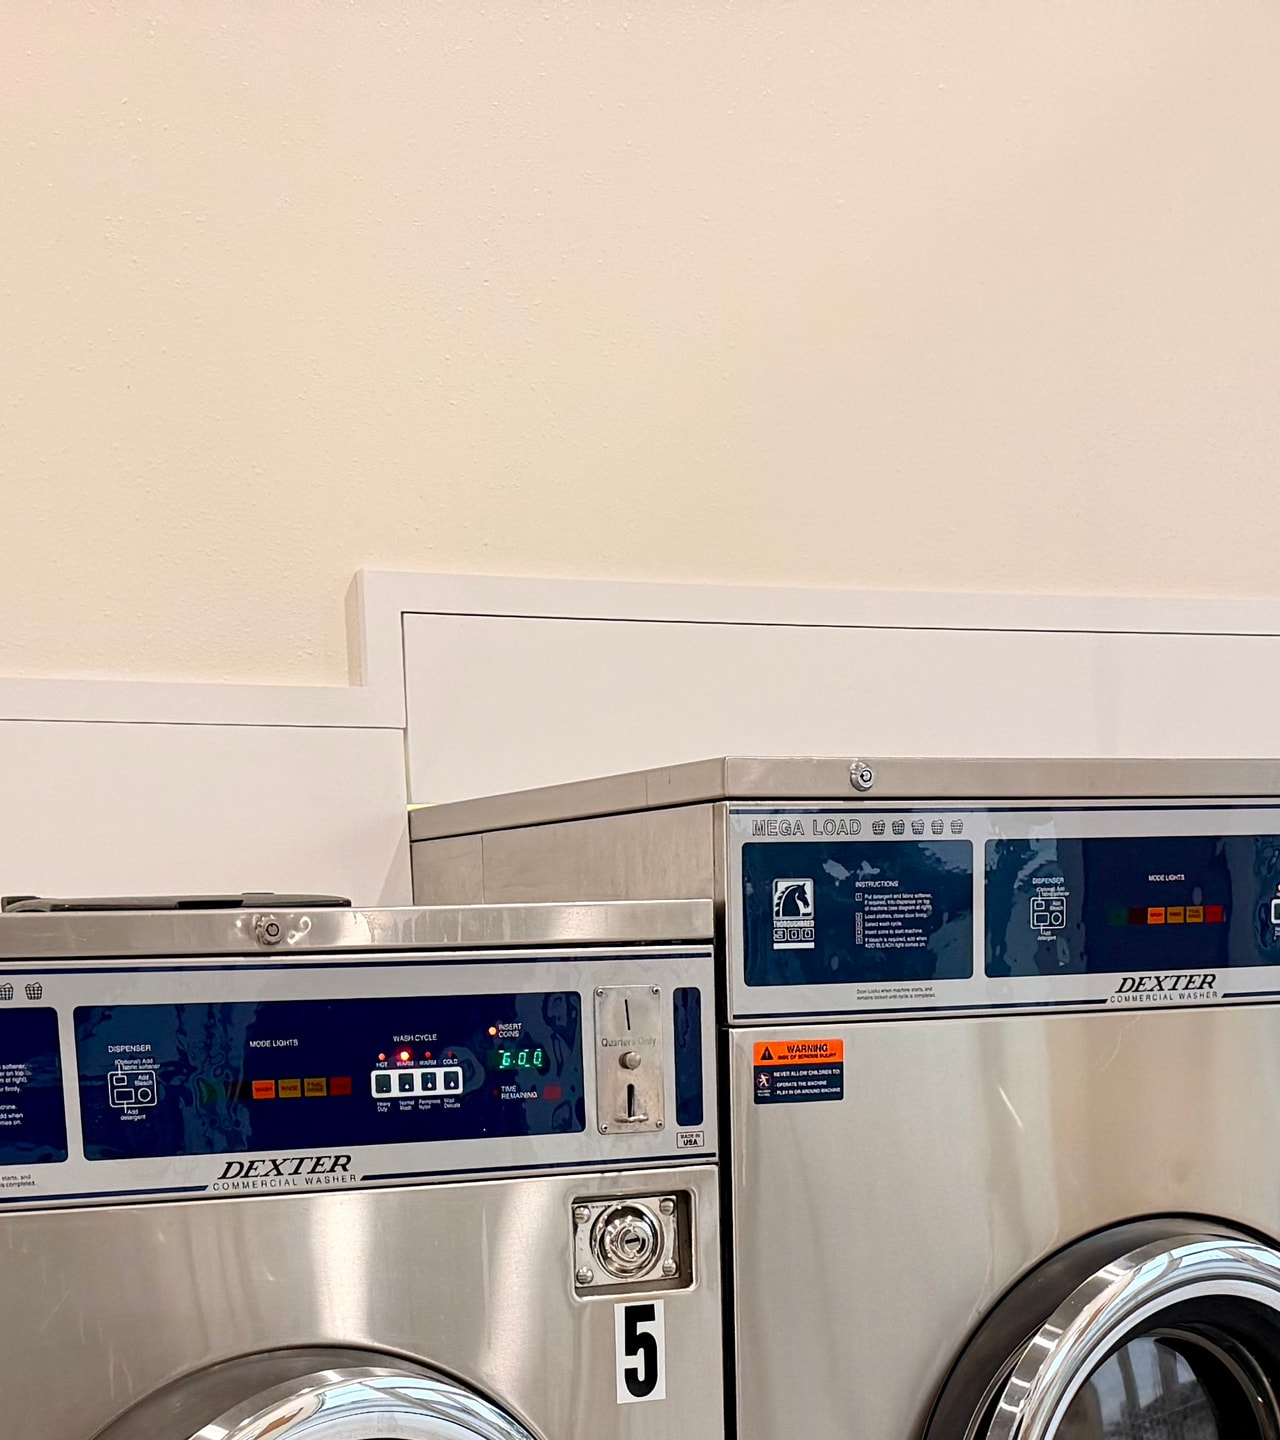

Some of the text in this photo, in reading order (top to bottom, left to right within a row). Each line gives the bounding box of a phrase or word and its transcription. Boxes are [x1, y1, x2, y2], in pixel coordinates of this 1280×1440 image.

[752, 819, 861, 836] MEGA LOAD
[1115, 974, 1216, 993] DEXTER
[1110, 991, 1218, 1003] COMMERCIAL WASHER
[250, 1039, 298, 1048] MODE LIGHTS
[787, 1044, 828, 1053] WARNING
[217, 1154, 352, 1180] DEXTER
[213, 1174, 356, 1190] COMMERCIAL WASHER
[625, 1304, 658, 1398] 5
